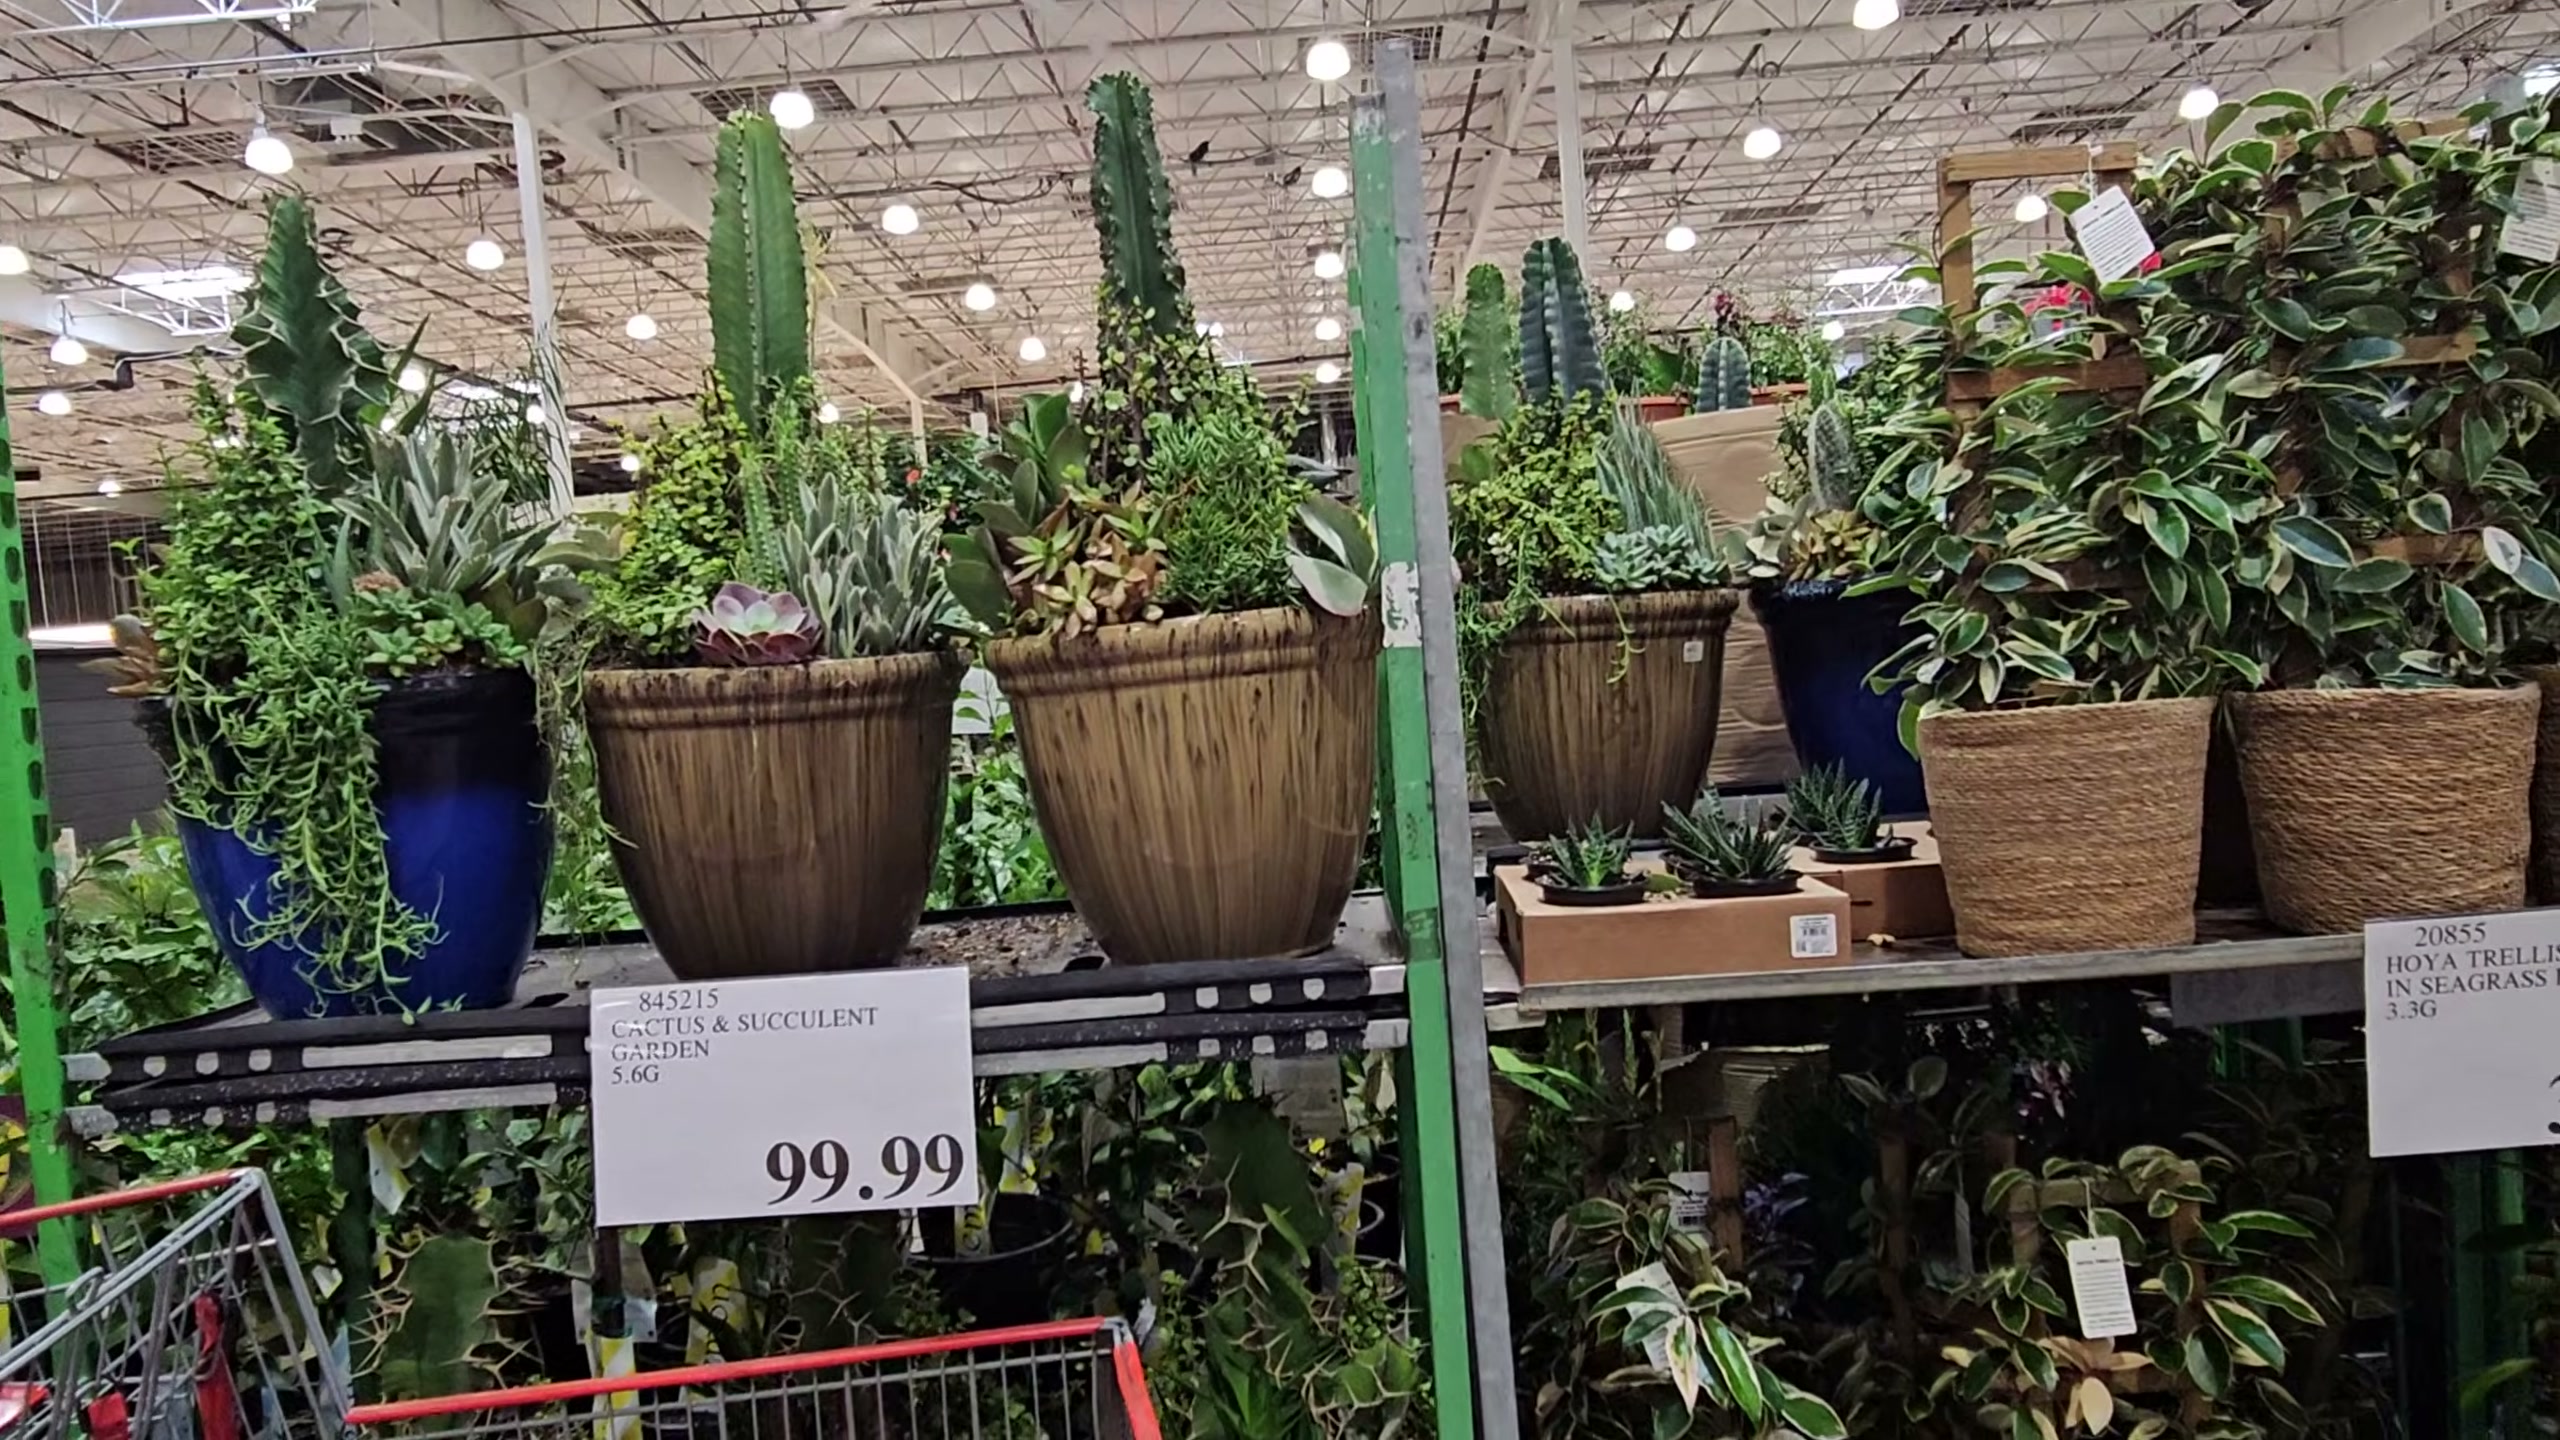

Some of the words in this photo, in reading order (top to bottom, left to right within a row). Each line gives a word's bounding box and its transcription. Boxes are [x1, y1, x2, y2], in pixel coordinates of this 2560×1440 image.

[2415, 922, 2487, 948] 20855
[2387, 952, 2458, 975] HOYA
[2387, 978, 2412, 998] IN
[2420, 969, 2548, 996] SEAGRASS
[639, 987, 719, 1012] 845215
[2386, 1000, 2437, 1021] 3.3G
[611, 1015, 705, 1039] CACTUS
[712, 1016, 730, 1033] &
[737, 1007, 879, 1032] SUCCULENT
[611, 1039, 710, 1061] GARDEN
[611, 1064, 660, 1085] 5.6G
[766, 1133, 964, 1206] 99.99
